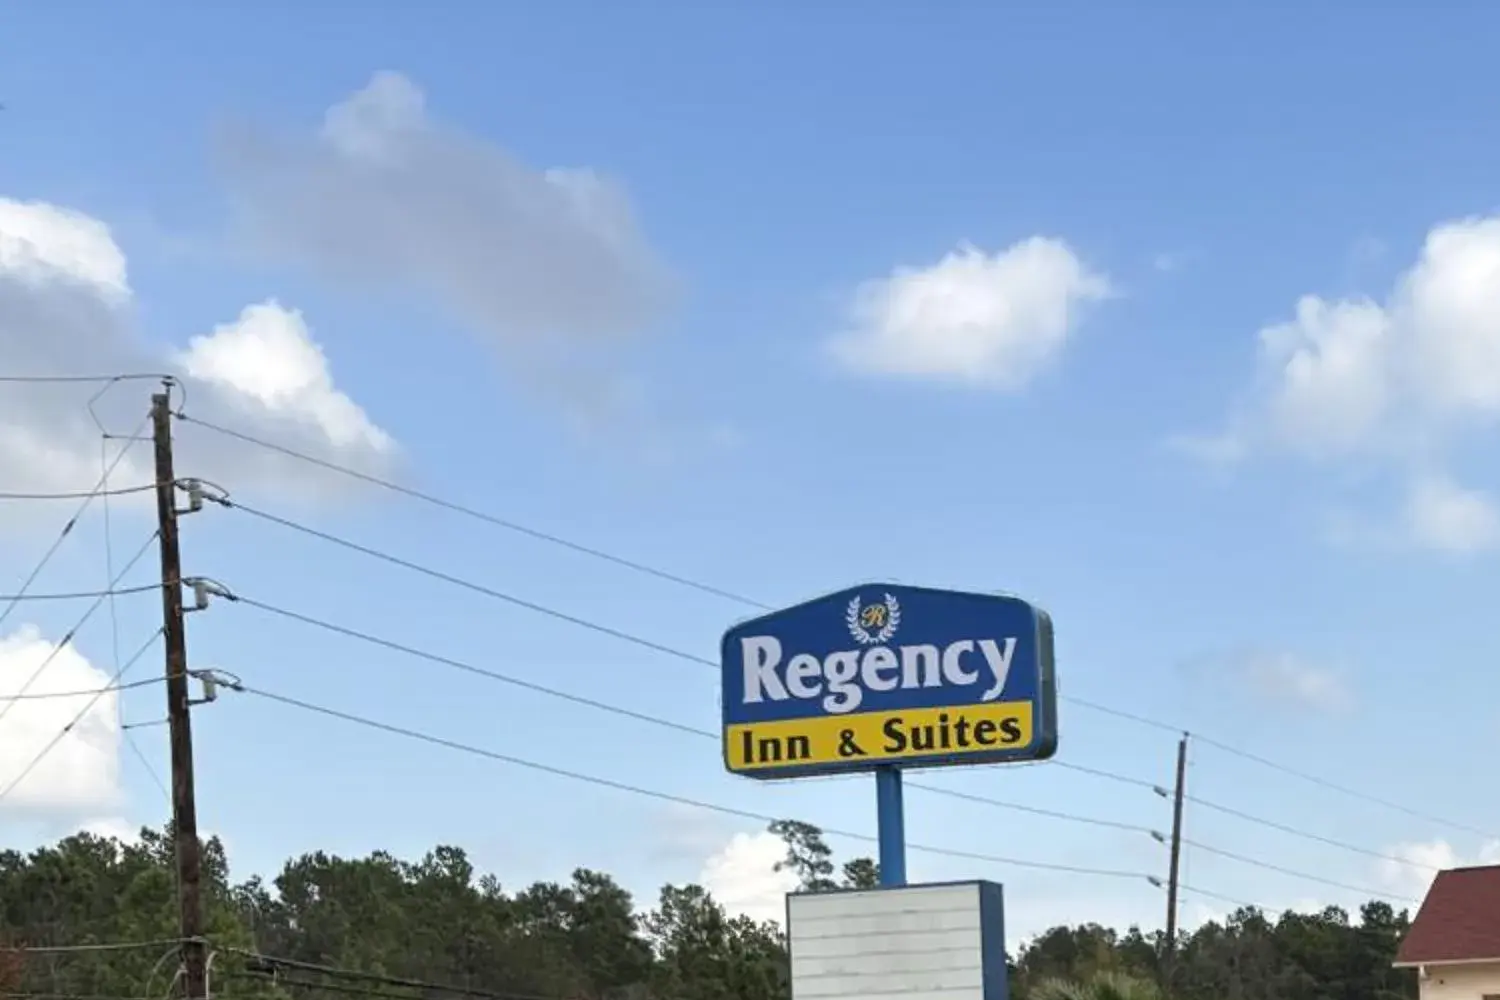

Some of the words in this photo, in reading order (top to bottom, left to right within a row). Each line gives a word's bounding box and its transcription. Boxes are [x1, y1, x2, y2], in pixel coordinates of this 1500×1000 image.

[740, 635, 1018, 714] Regency
[742, 729, 812, 764] Inn
[837, 729, 868, 757] &
[883, 713, 1022, 754] Suites
